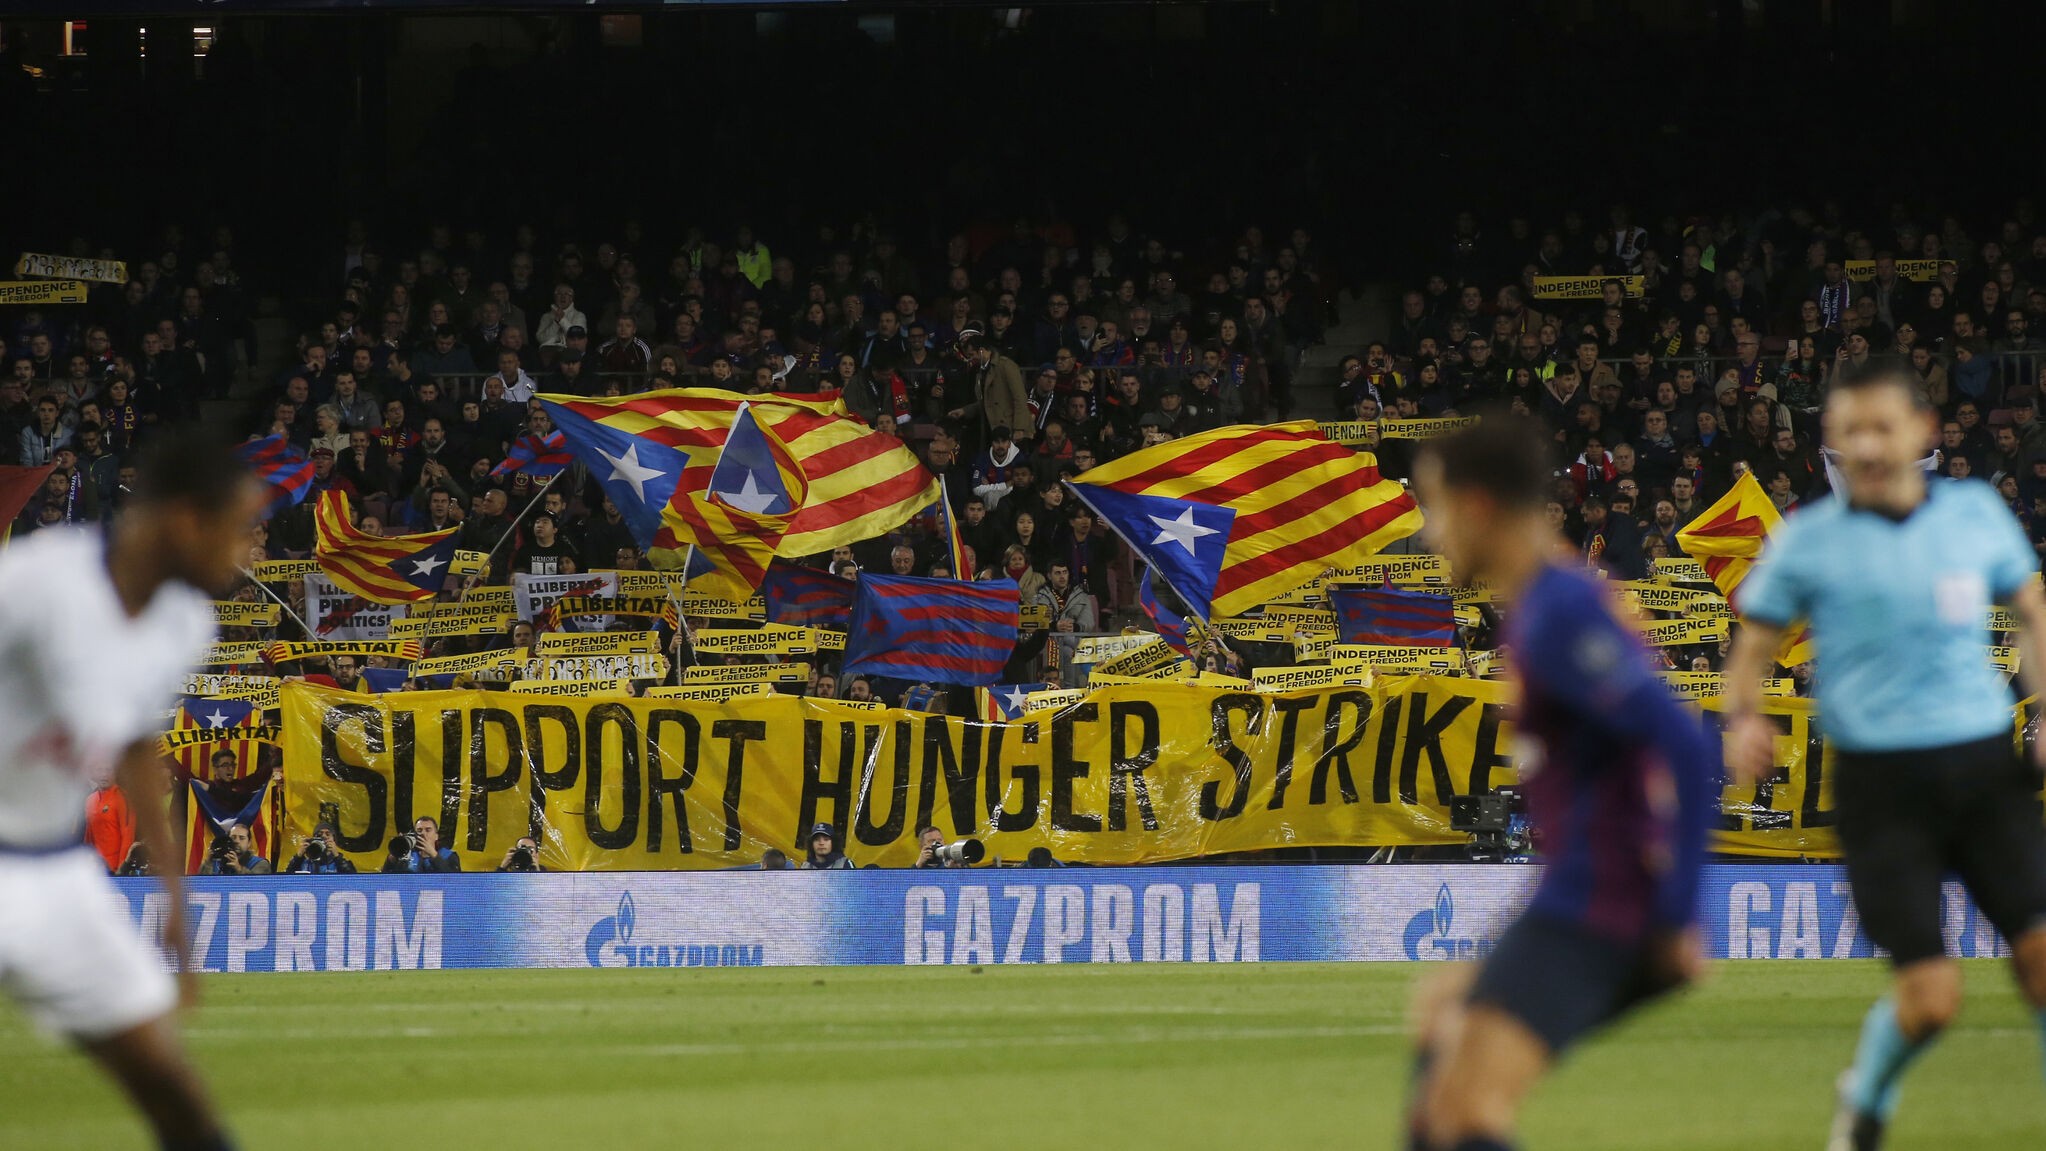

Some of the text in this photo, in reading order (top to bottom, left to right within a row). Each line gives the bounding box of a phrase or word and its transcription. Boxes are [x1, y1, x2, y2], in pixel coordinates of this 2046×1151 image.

[0, 282, 76, 296] EPENDENCE
[9, 293, 50, 302] FREEDOM
[560, 598, 666, 614] LLIBERTAT
[393, 615, 497, 633] NDEPENDENCE
[541, 632, 647, 649] NDEPENDENCE
[695, 630, 806, 647] INDEPENDENCE
[289, 642, 400, 655] LLIBERTAT
[572, 644, 618, 653] FREEDOM
[730, 643, 777, 652] FREEDOM
[1332, 648, 1447, 659] INDEPENDENCE
[444, 661, 487, 672] FREEDOM
[1129, 649, 1172, 674] FREEDOM
[1370, 657, 1417, 665] FREEDOM
[686, 664, 798, 678] INDEPENDENCE
[721, 672, 768, 681] FREEDOM
[1286, 678, 1332, 688] FREEDOM
[166, 726, 282, 749] LLIBERTAT
[320, 702, 767, 853] SUPPORT
[795, 700, 1161, 850] HUNGER
[903, 882, 1261, 966] GAZPROM
